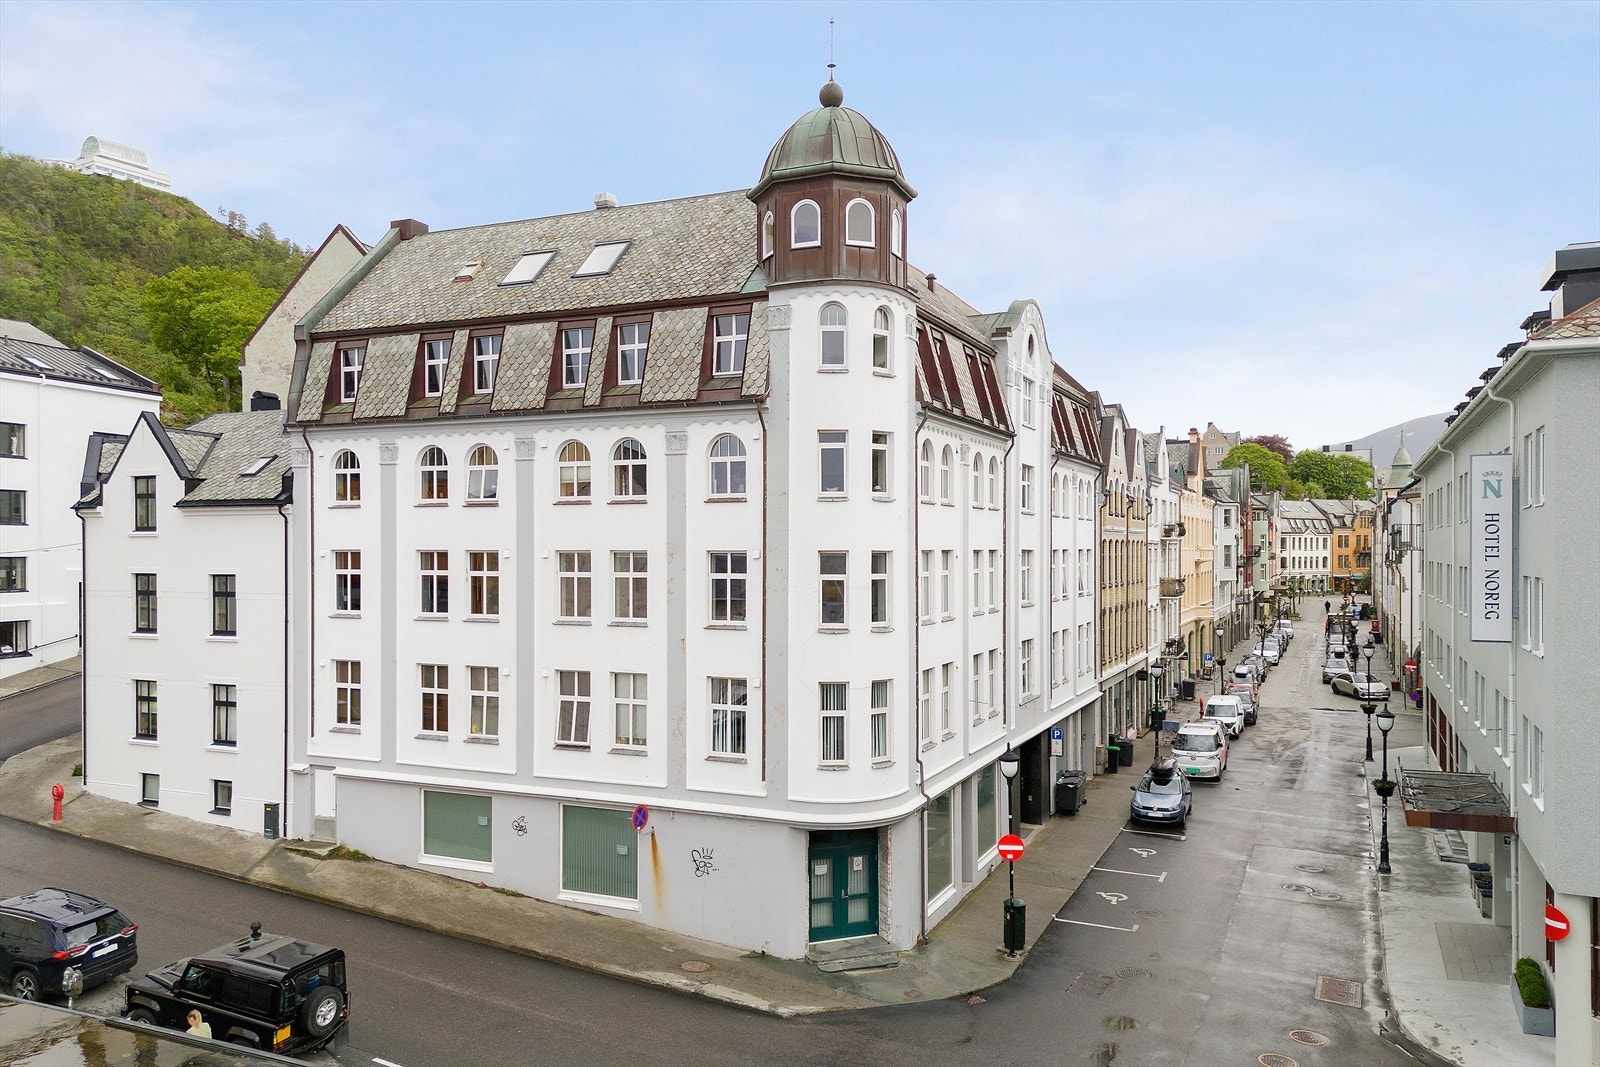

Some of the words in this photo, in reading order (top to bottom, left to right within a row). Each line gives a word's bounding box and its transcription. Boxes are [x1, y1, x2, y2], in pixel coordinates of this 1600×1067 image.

[1482, 479, 1503, 499] N
[1485, 513, 1500, 562] HOTEL
[1485, 570, 1500, 620] NOREG
[1054, 730, 1061, 739] P
